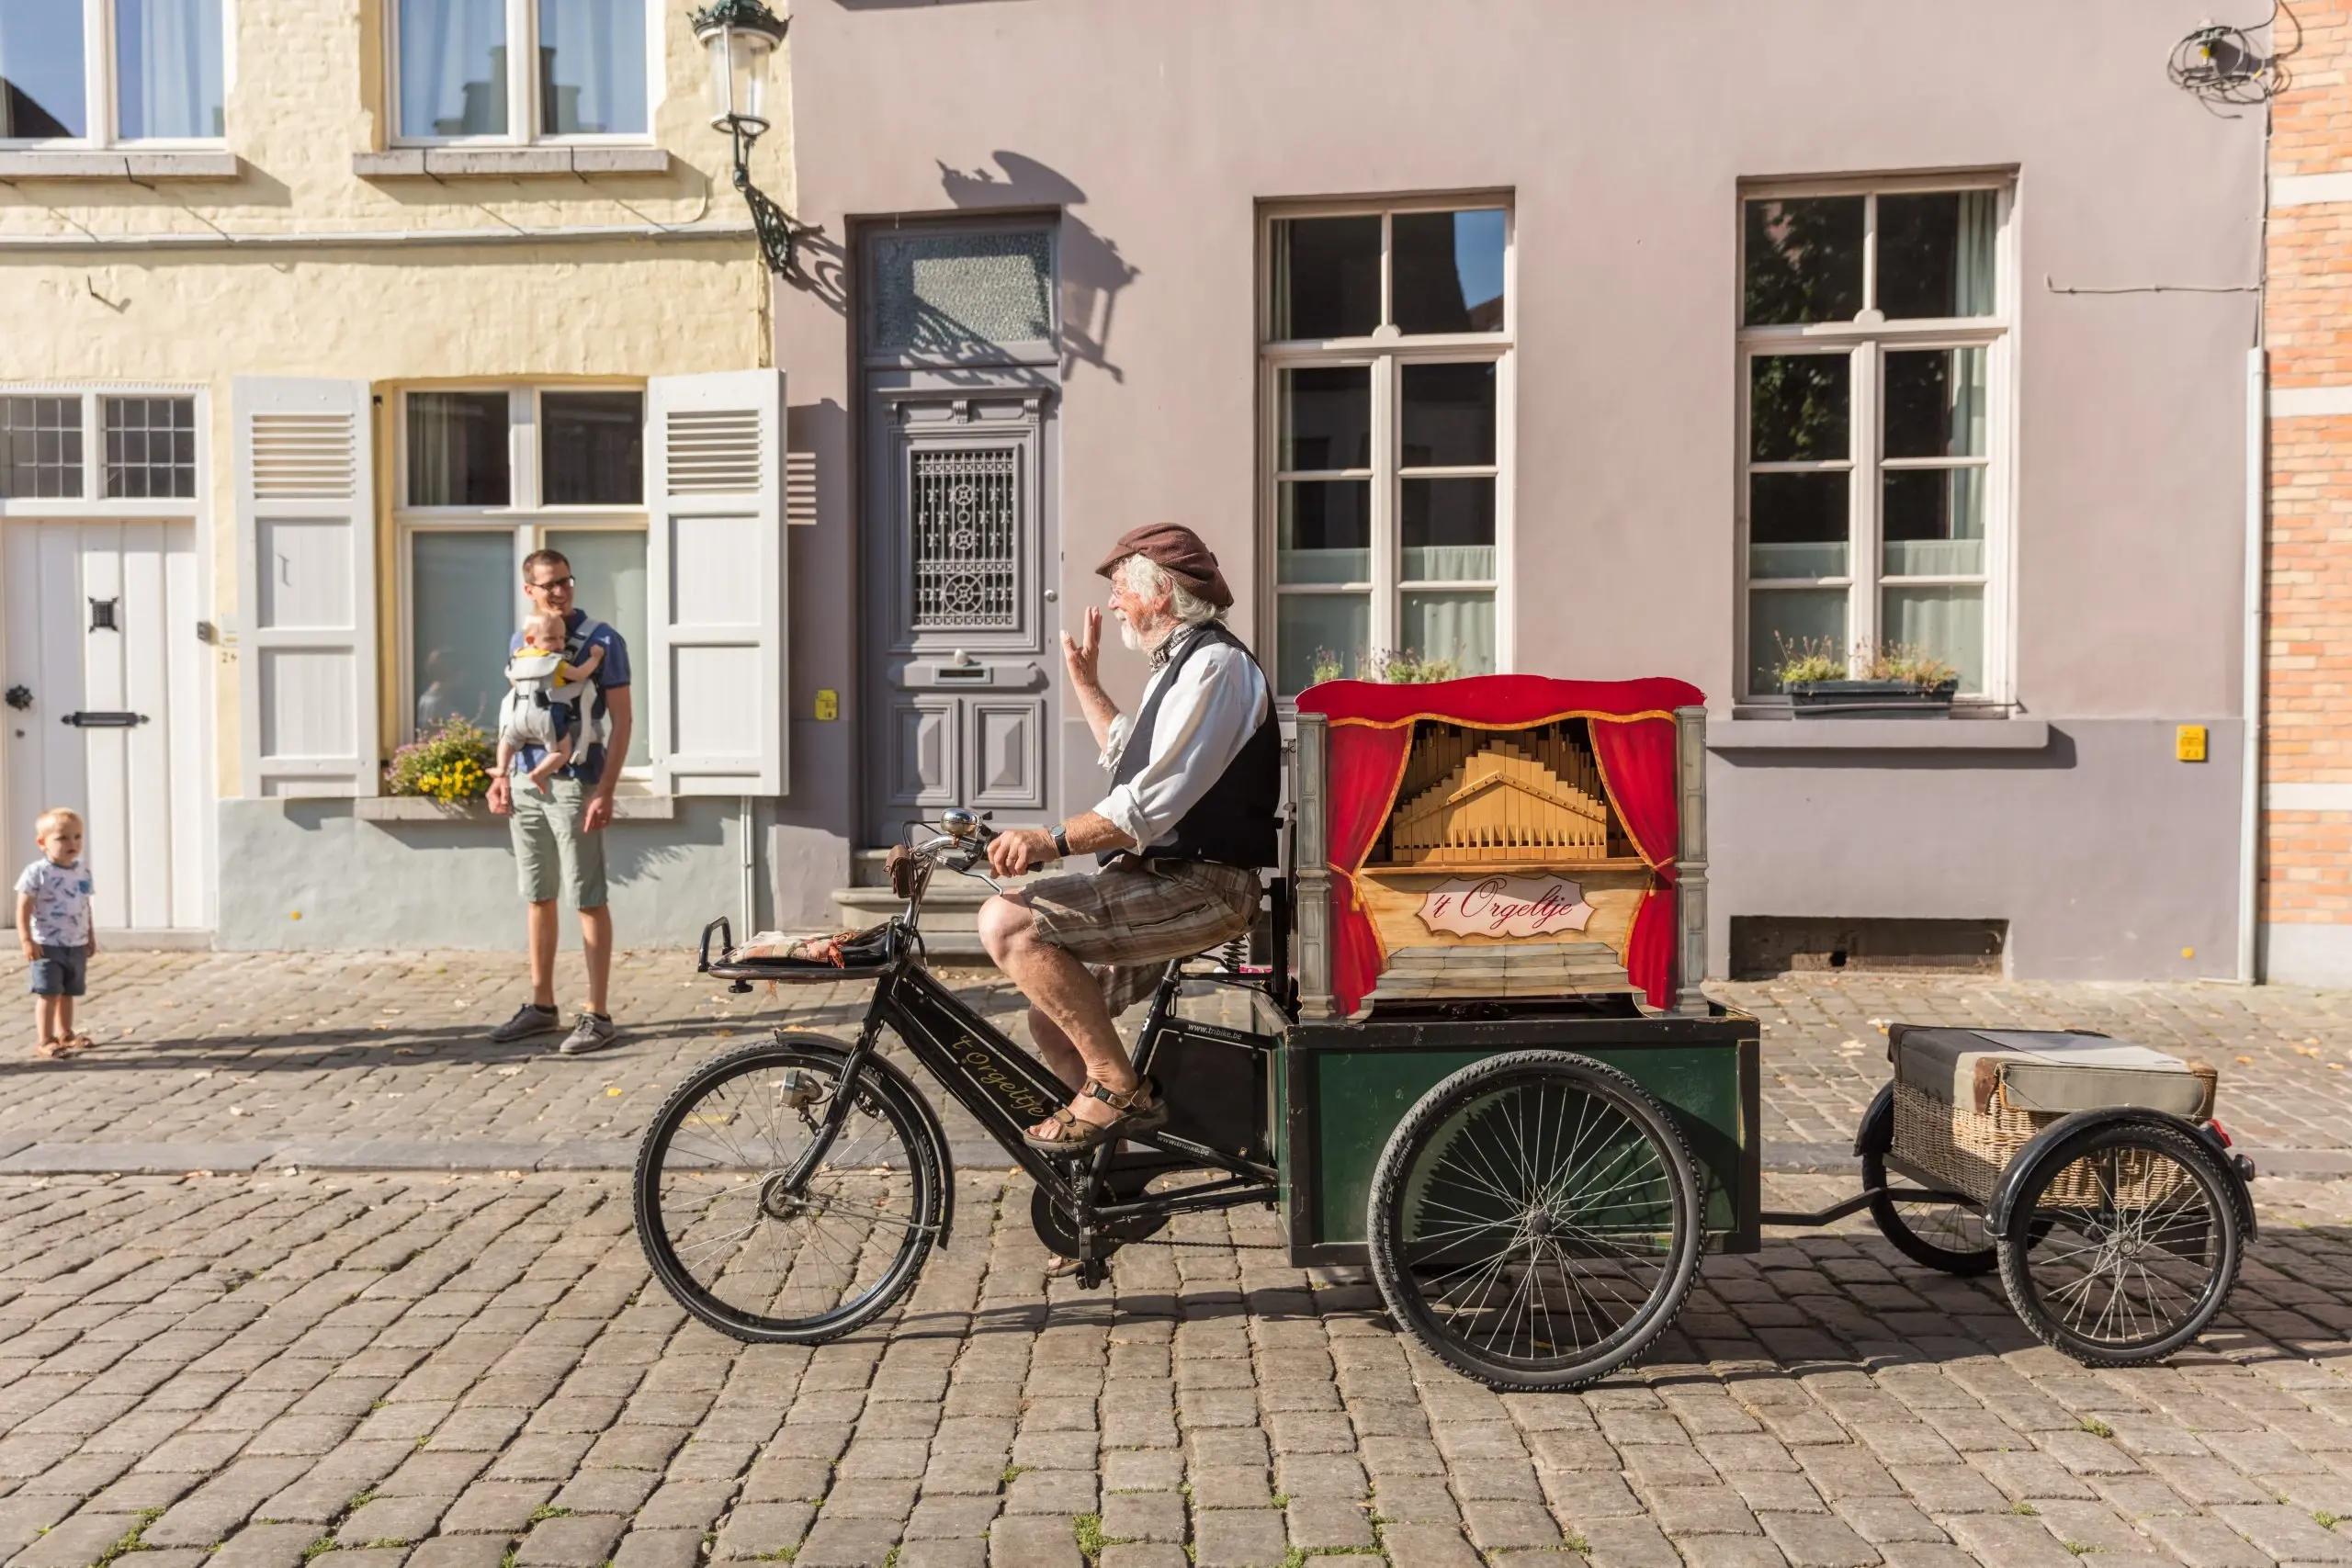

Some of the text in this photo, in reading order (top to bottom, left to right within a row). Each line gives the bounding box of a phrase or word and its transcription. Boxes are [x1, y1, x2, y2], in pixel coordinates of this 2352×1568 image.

[1460, 877, 1573, 930] Orgeltje
[1188, 1023, 1243, 1041] www.tribike.be
[966, 1052, 1048, 1117] Orgeltje
